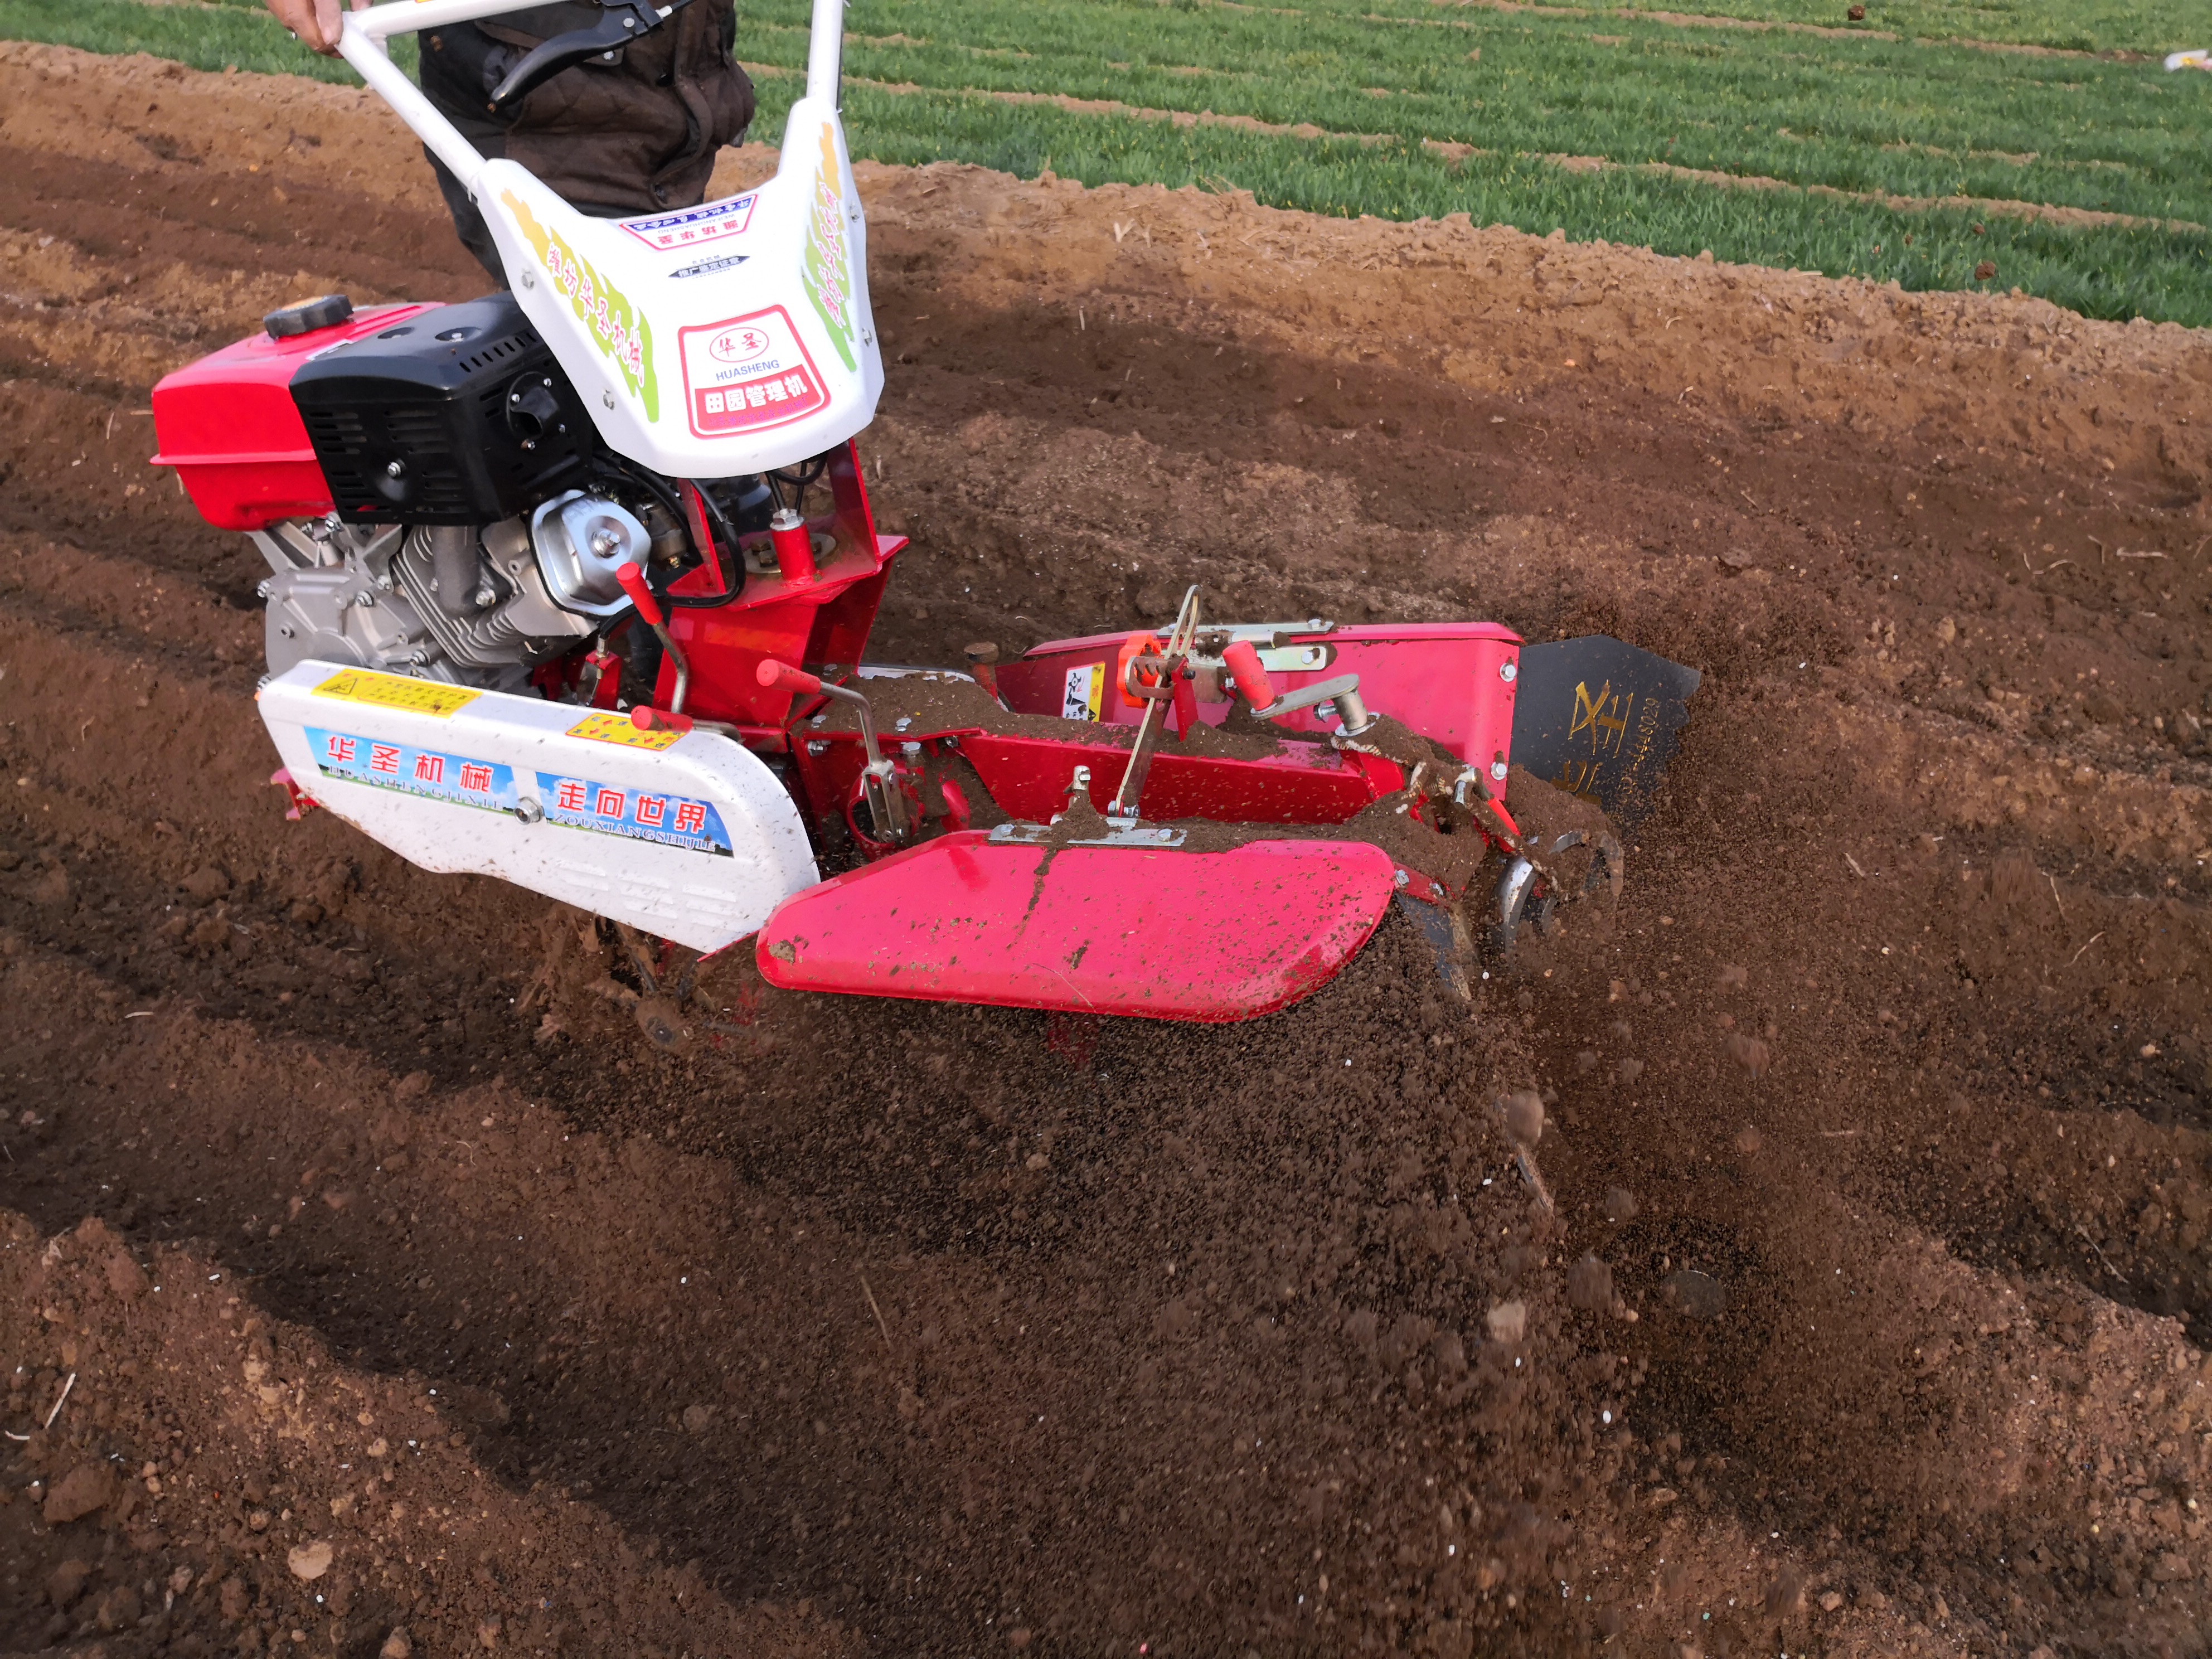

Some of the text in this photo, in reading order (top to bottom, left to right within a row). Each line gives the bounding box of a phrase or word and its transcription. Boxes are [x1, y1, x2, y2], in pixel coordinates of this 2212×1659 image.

[547, 242, 644, 387] 潍坊华圣机械
[719, 332, 761, 357] 华圣
[705, 374, 808, 414] 田园管理机
[716, 360, 780, 381] HUASHENG
[327, 765, 716, 852] HUASHENGJIXIE ZOUXIANGSHIJIE
[328, 735, 707, 834] 华圣机械 走向世界
